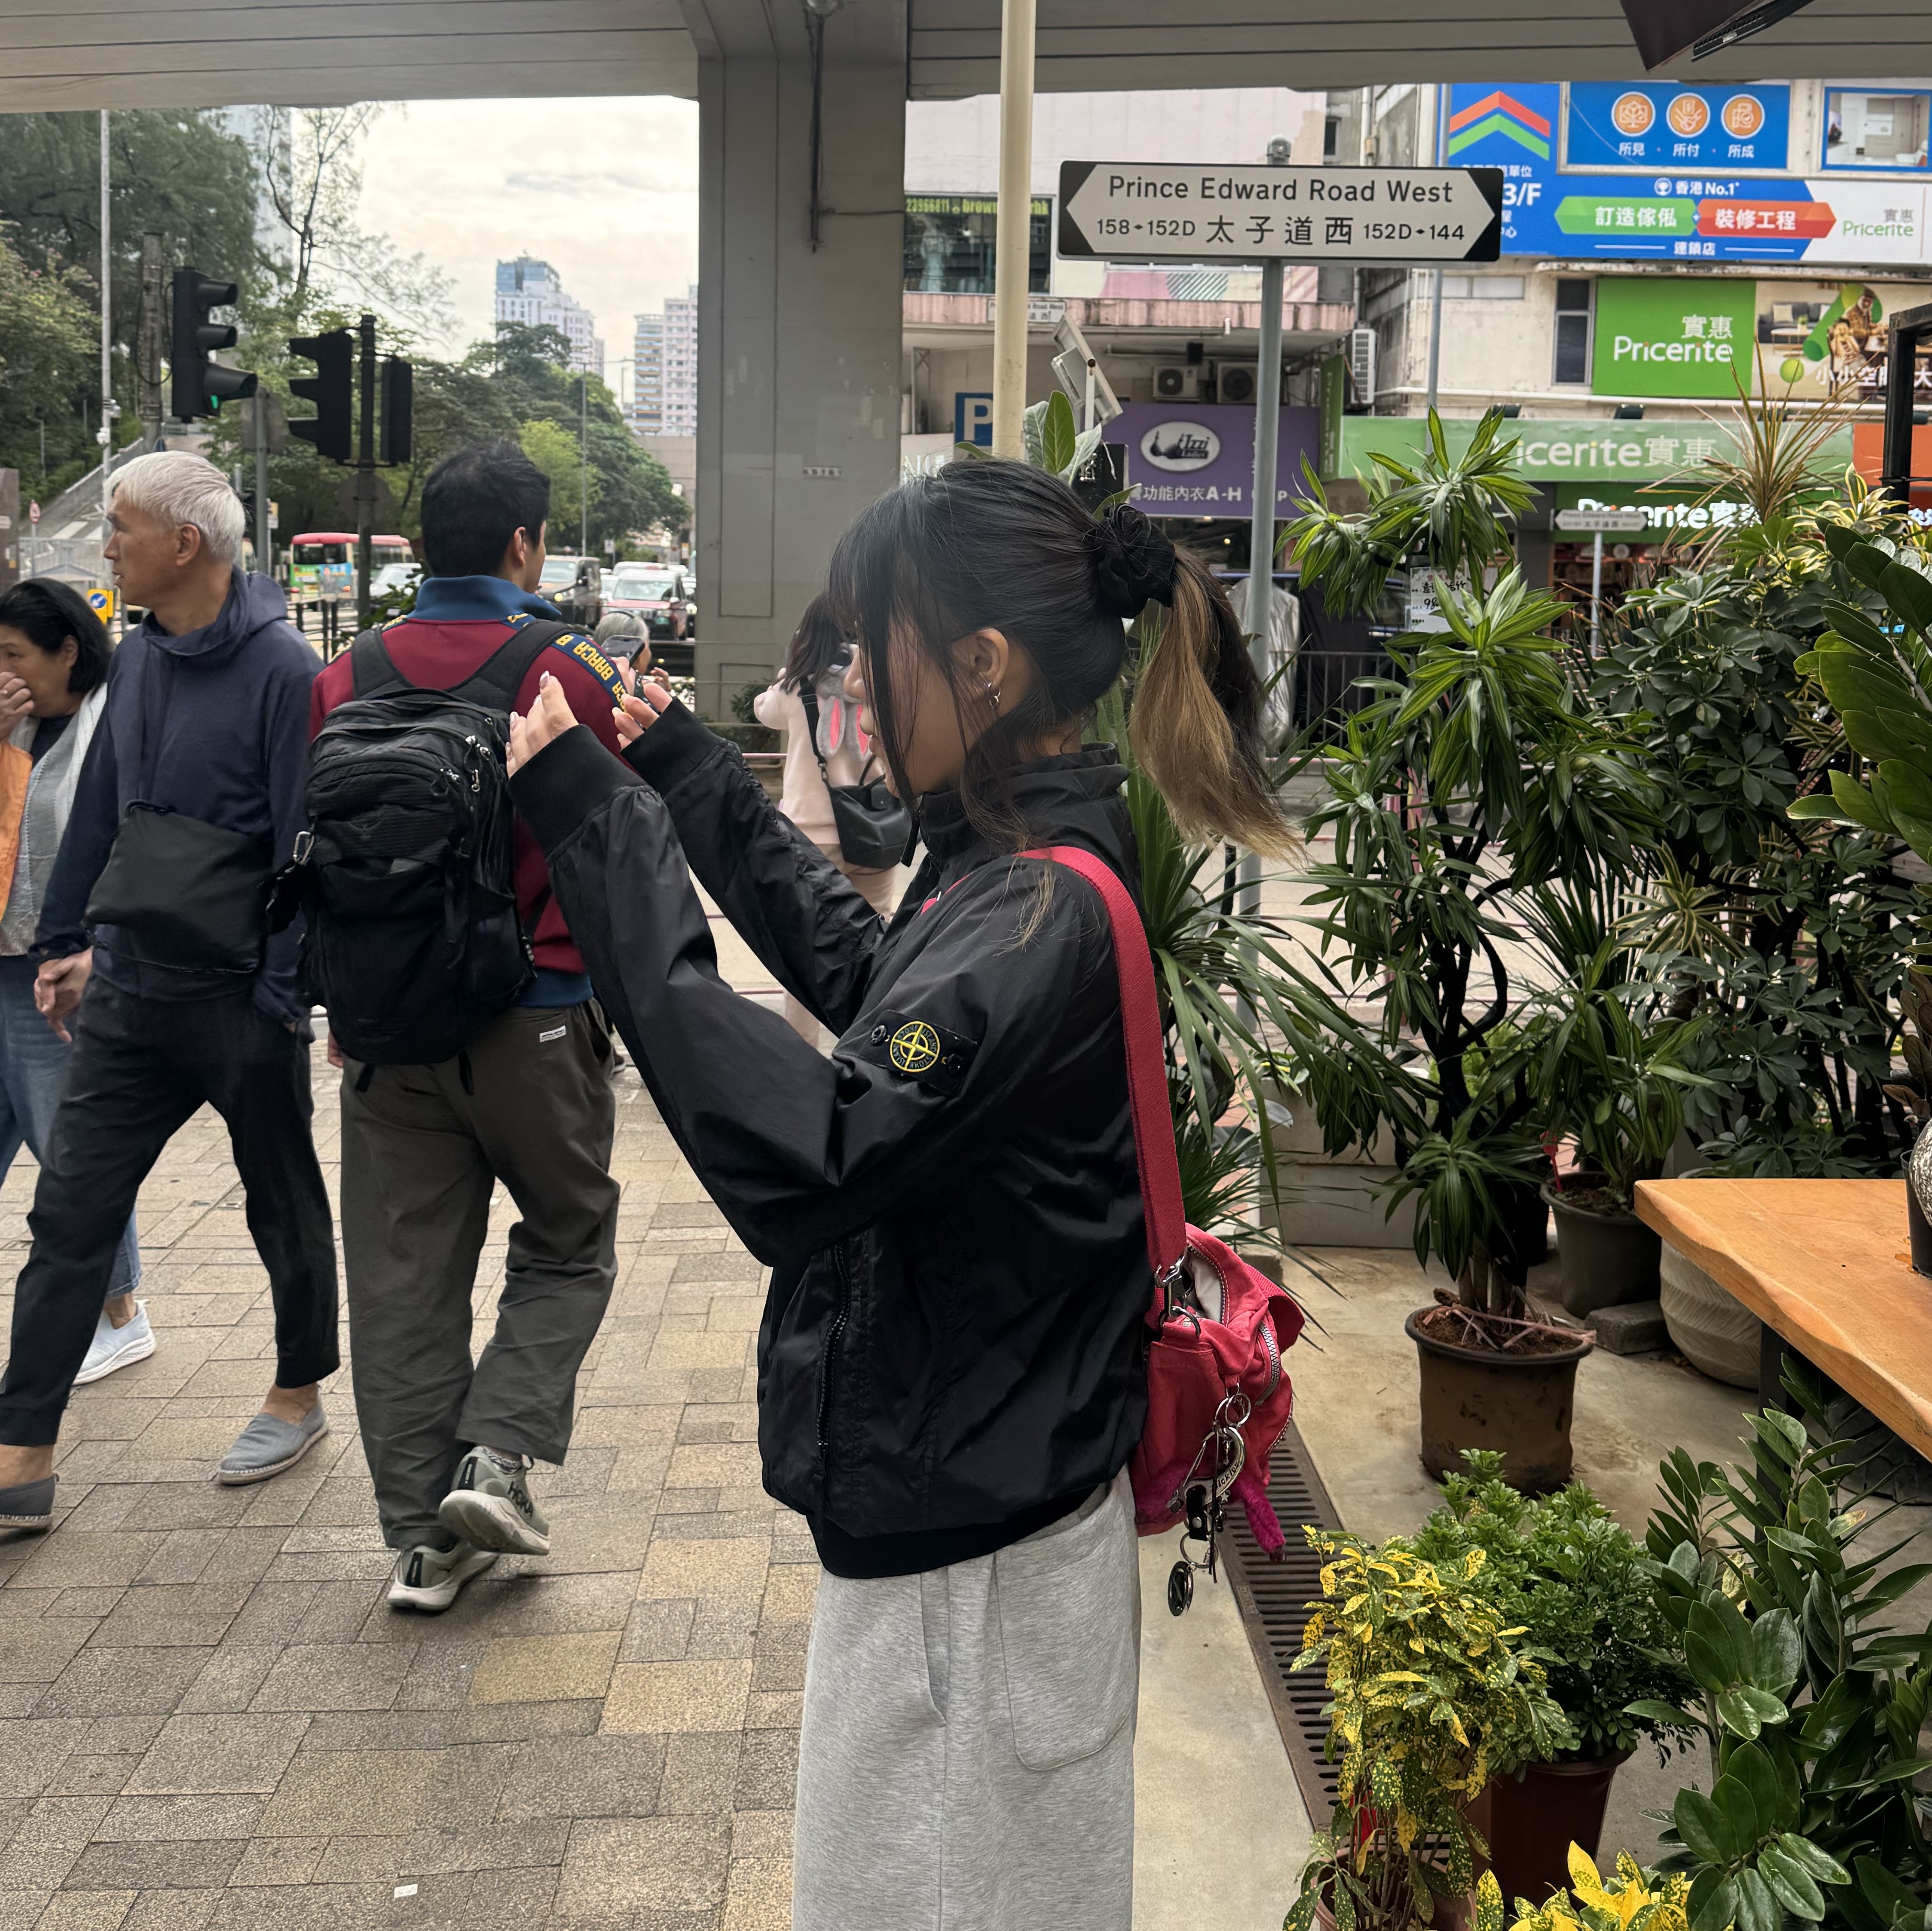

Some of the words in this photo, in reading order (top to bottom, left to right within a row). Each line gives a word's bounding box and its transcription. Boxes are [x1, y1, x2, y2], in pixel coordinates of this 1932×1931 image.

[1618, 142, 1645, 156] 所見
[1673, 143, 1699, 157] 所付
[1728, 144, 1755, 158] 所成
[1109, 176, 1188, 198] Prince
[1201, 177, 1296, 201] Edward
[1310, 179, 1375, 201] Road
[1387, 180, 1453, 203] West
[1206, 214, 1354, 245] 太子道西
[1595, 206, 1677, 228] 訂造傢俬
[1714, 208, 1796, 231] 裝修工程
[1842, 220, 1914, 236] Pricerite
[1681, 314, 1733, 339] 實惠
[1614, 335, 1733, 363] Pricerite
[964, 397, 993, 441] P
[508, 1481, 534, 1518] HOKA
